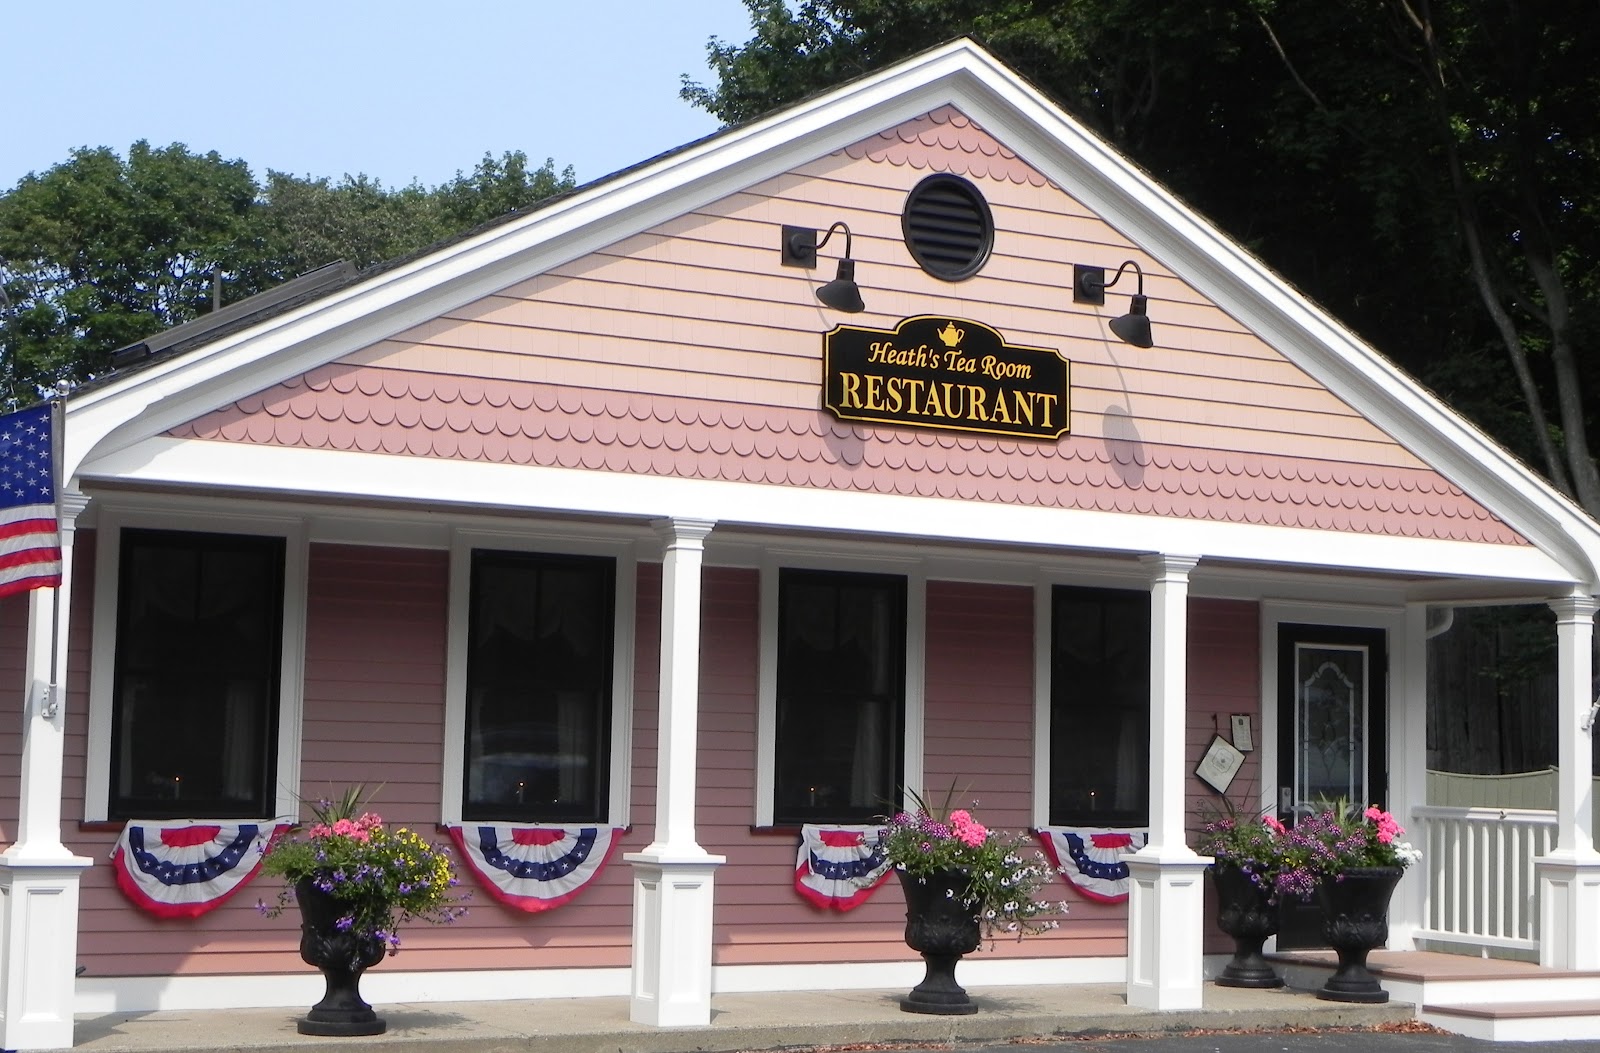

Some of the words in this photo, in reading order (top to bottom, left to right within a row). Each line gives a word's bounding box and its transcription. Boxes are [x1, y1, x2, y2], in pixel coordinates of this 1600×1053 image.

[867, 341, 940, 369] Heath's
[943, 350, 976, 374] Tea
[982, 355, 1032, 380] Room
[839, 371, 1058, 428] RESTAURANT
